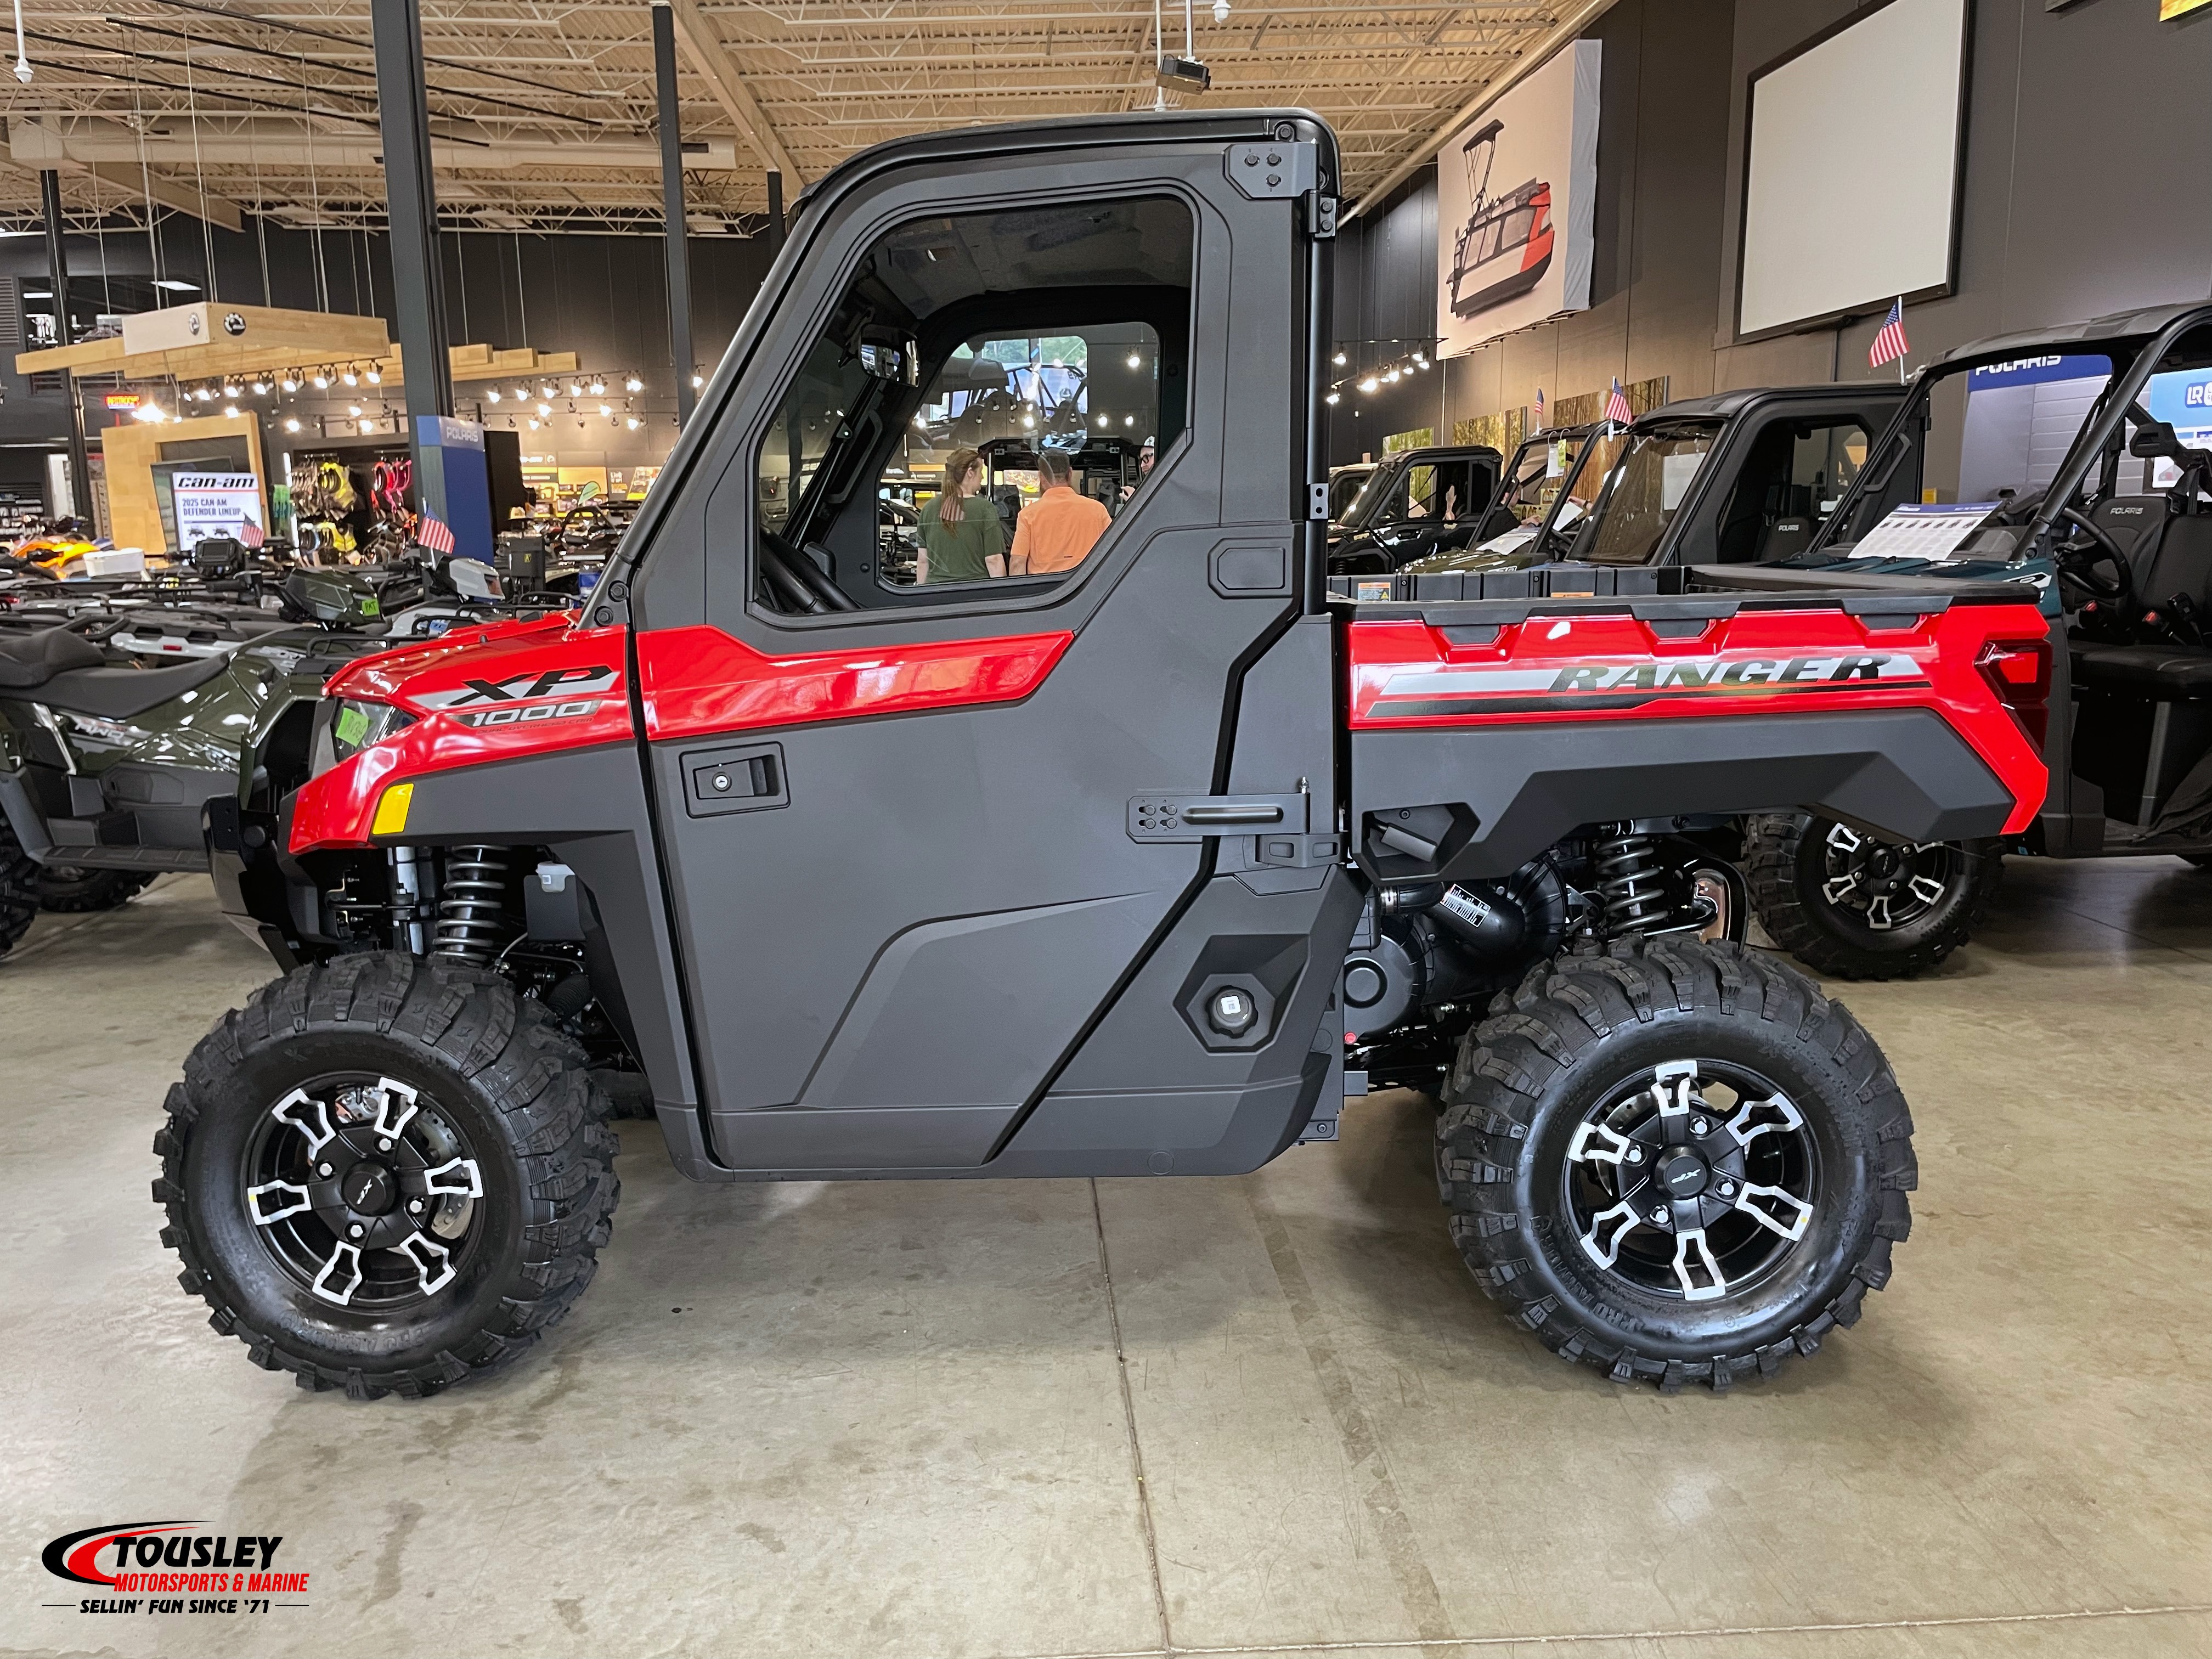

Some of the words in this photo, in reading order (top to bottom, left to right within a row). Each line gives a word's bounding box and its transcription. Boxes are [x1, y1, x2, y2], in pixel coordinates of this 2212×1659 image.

[446, 426, 478, 442] POLARIS
[178, 477, 255, 488] can-am
[182, 498, 199, 506] 2025
[183, 508, 216, 516] DEFENDER
[1548, 654, 1892, 693] RANGER
[449, 665, 613, 706] XP
[473, 701, 592, 727] 1000
